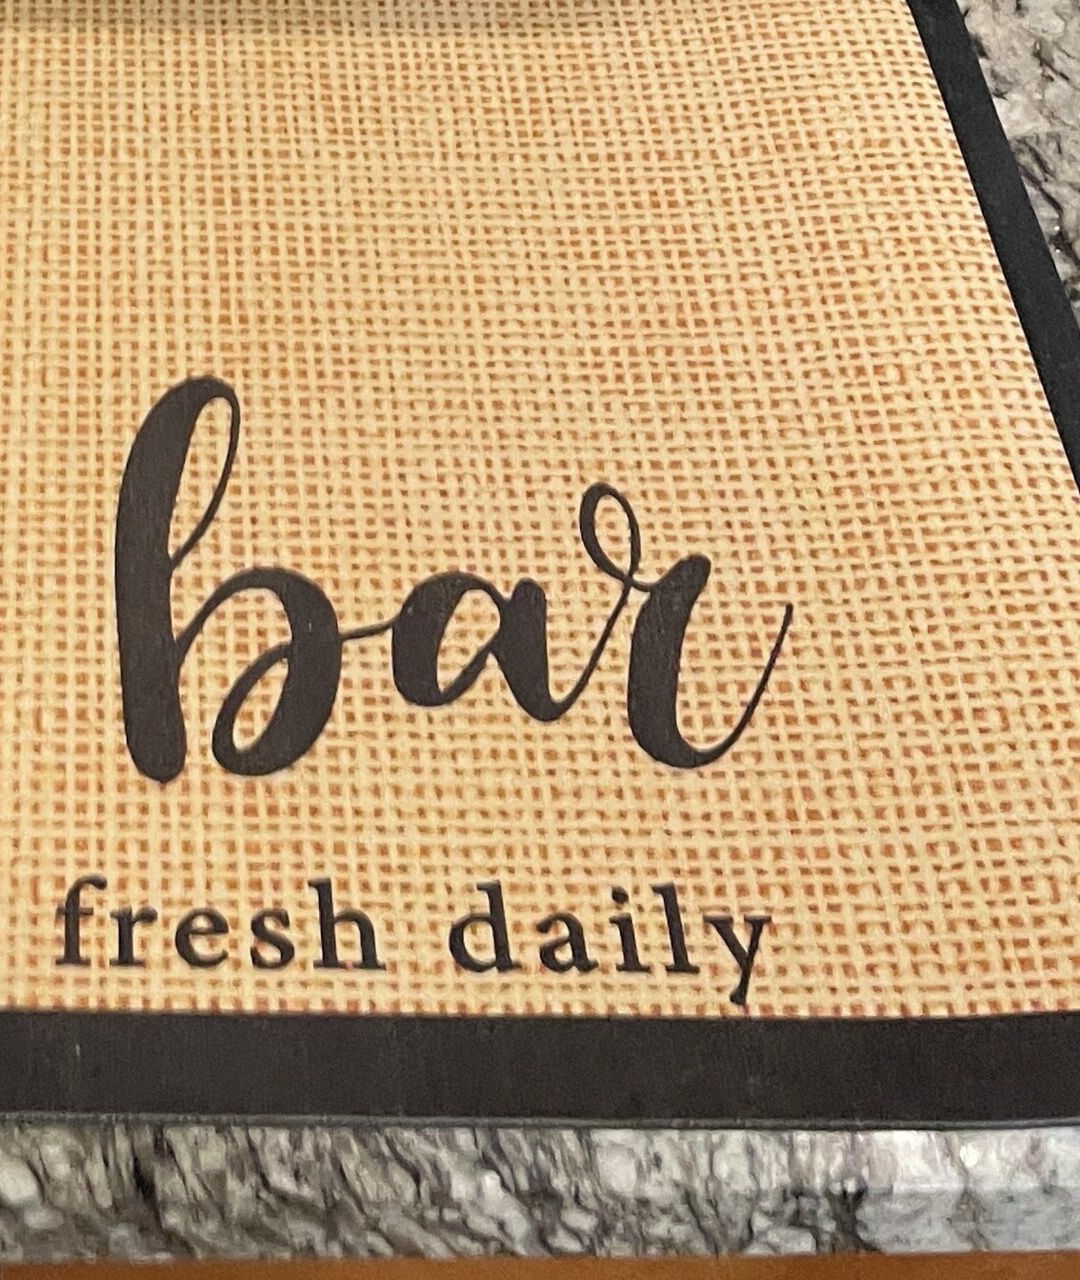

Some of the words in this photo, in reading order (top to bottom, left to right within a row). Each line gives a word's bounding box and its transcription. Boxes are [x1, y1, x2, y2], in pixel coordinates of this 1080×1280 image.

[116, 376, 793, 784] bar
[55, 877, 385, 971] fresh
[448, 881, 771, 1005] daily
